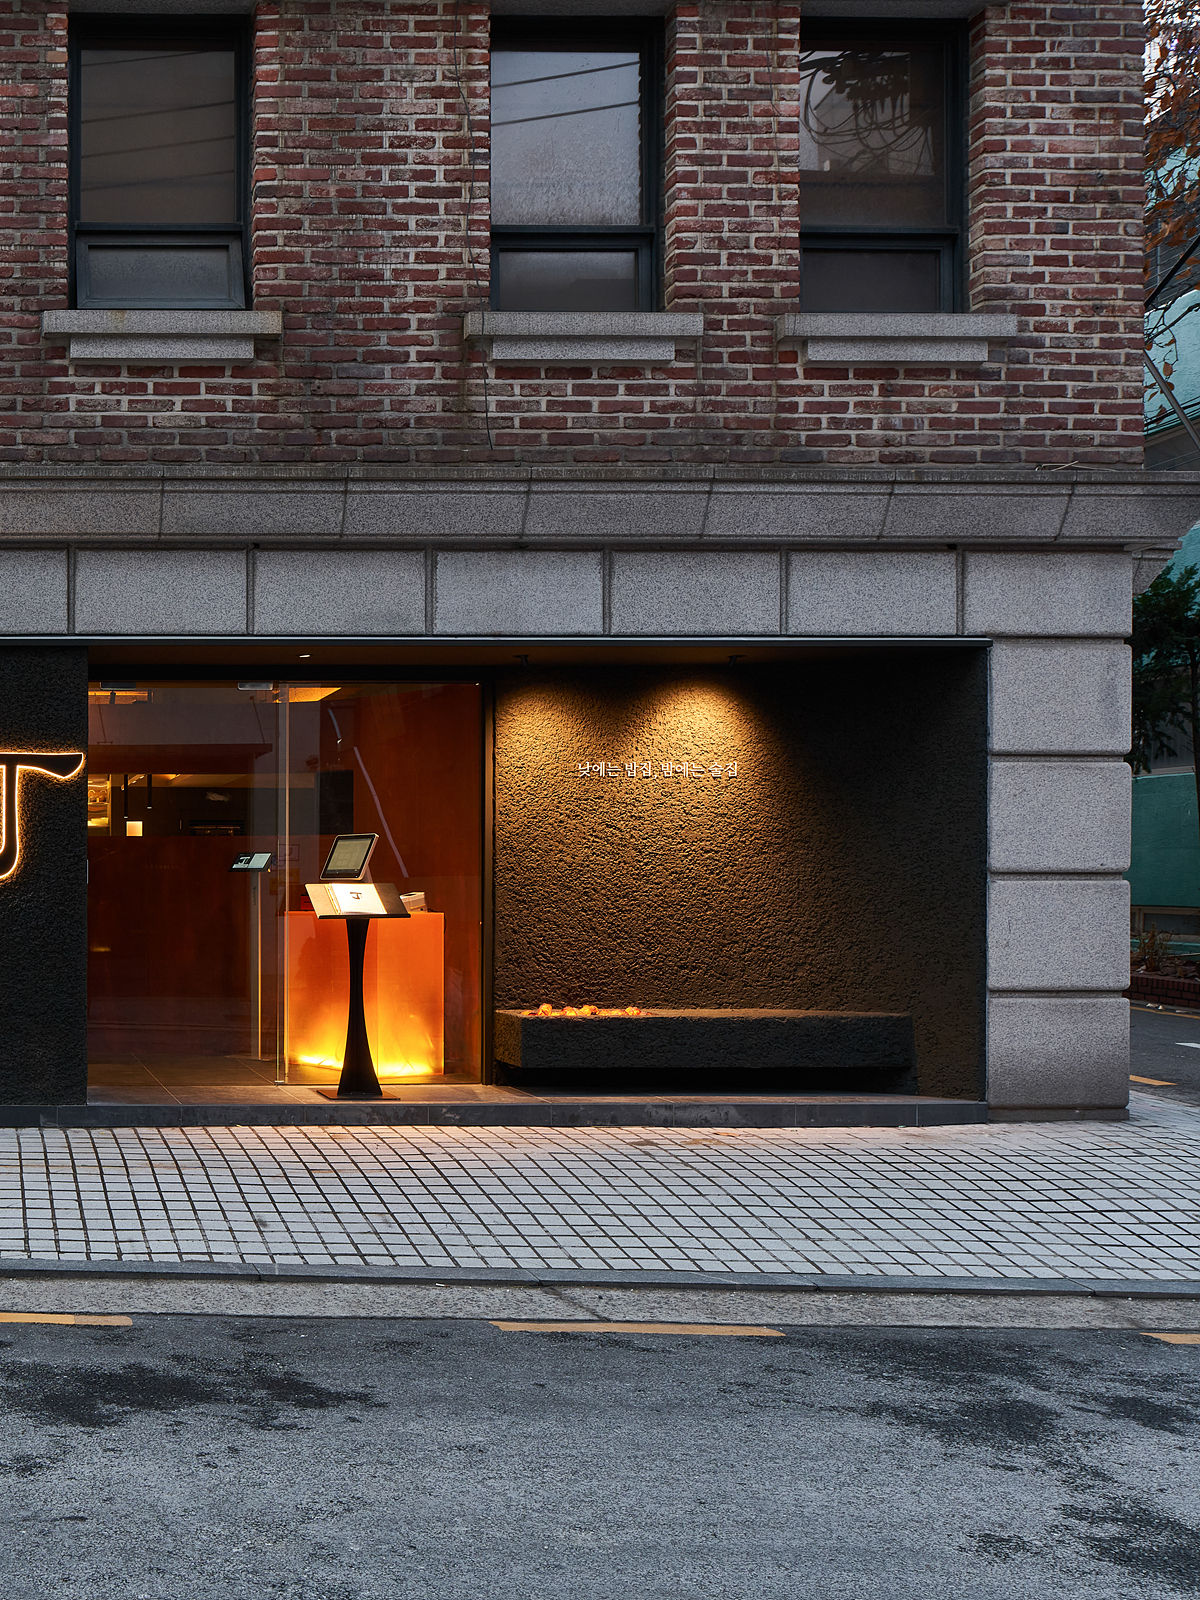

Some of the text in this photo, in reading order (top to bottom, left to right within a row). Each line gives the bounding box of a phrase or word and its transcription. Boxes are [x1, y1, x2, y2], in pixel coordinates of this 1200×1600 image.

[578, 761, 738, 779] 낮에는 밥집, 밤에는 술집
